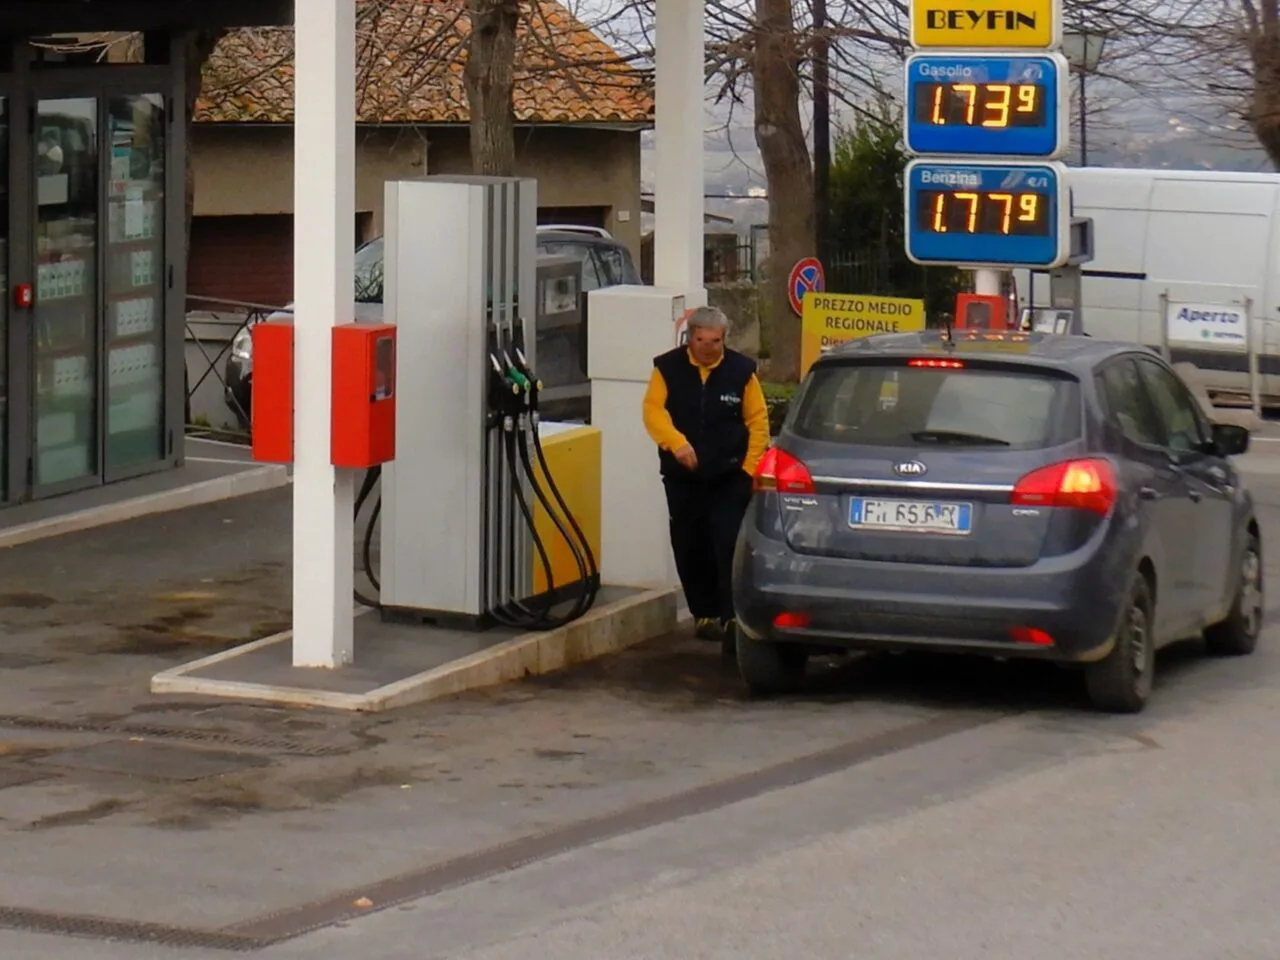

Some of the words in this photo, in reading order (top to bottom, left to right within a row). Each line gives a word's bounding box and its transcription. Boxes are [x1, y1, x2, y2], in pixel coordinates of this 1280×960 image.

[926, 9, 1037, 30] BEYFIN
[919, 63, 972, 77] Gasolio
[921, 170, 978, 185] Benzina
[814, 297, 865, 313] PREZZO
[868, 302, 913, 316] MEDIO
[1176, 307, 1240, 324] Aperto
[825, 316, 900, 333] REGIONALE
[899, 463, 921, 473] KIA
